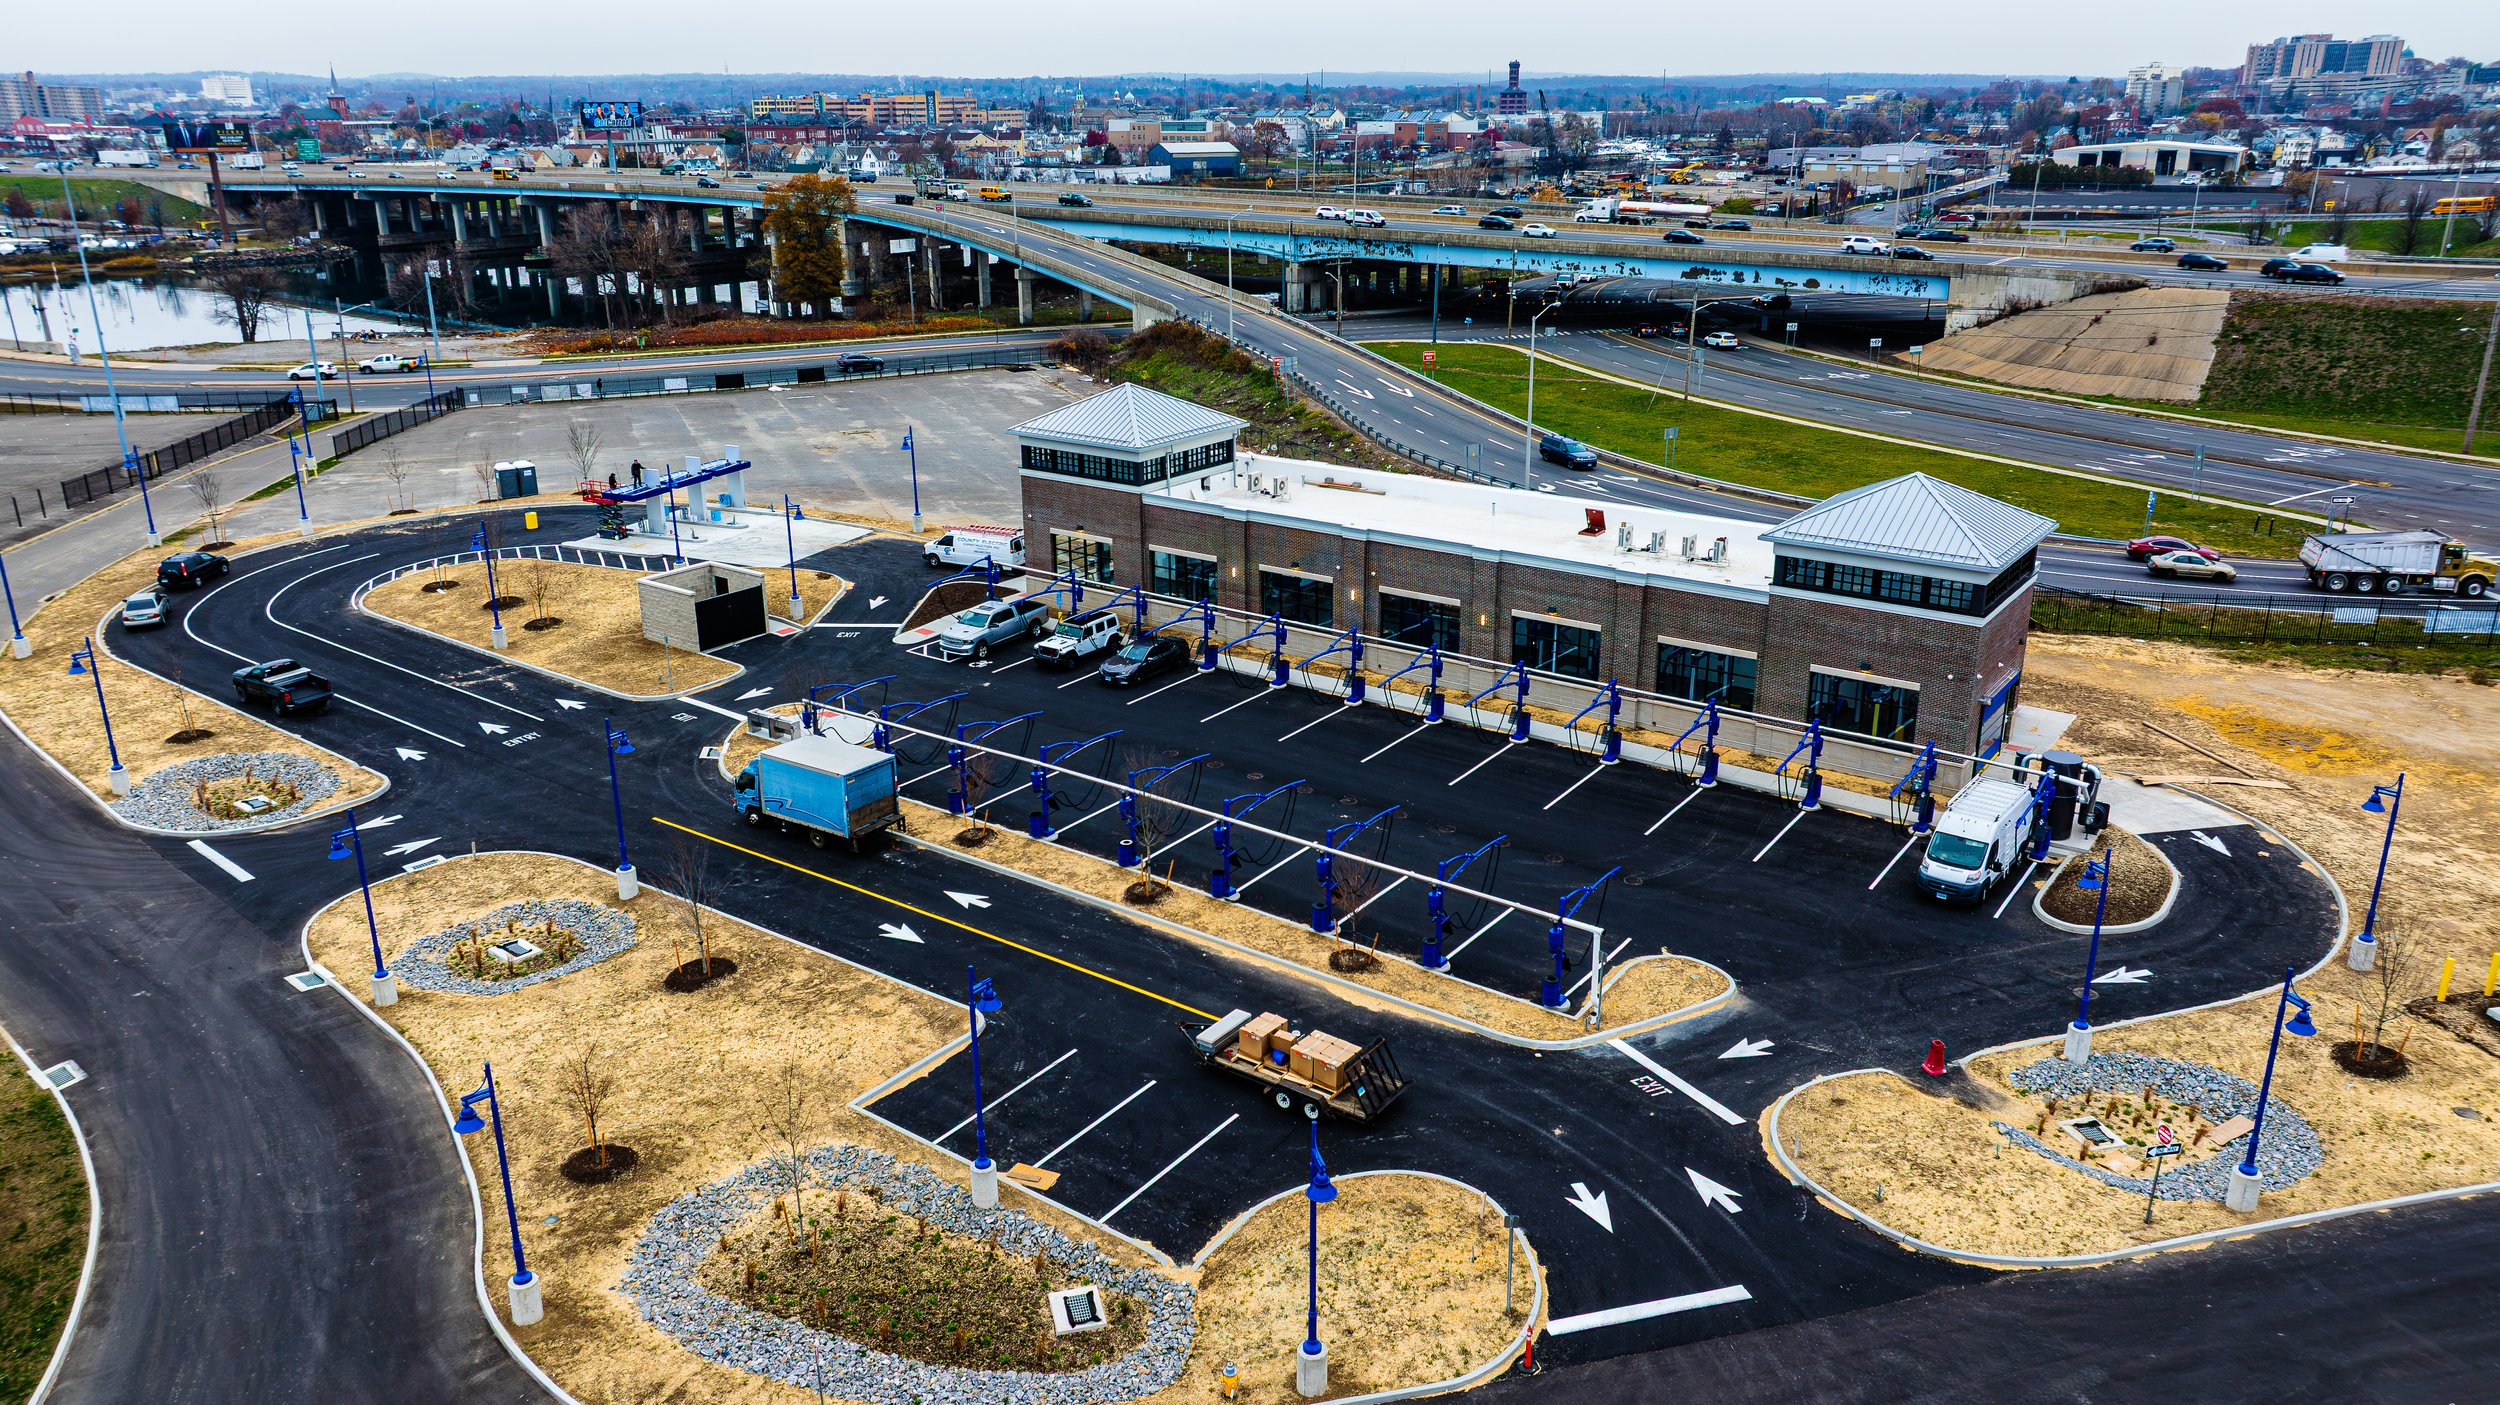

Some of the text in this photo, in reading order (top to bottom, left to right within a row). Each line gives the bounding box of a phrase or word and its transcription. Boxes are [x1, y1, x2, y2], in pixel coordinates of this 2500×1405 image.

[671, 712, 698, 722] EXIT
[502, 731, 541, 747] ENTRY
[1630, 1075, 1673, 1097] EXIT
